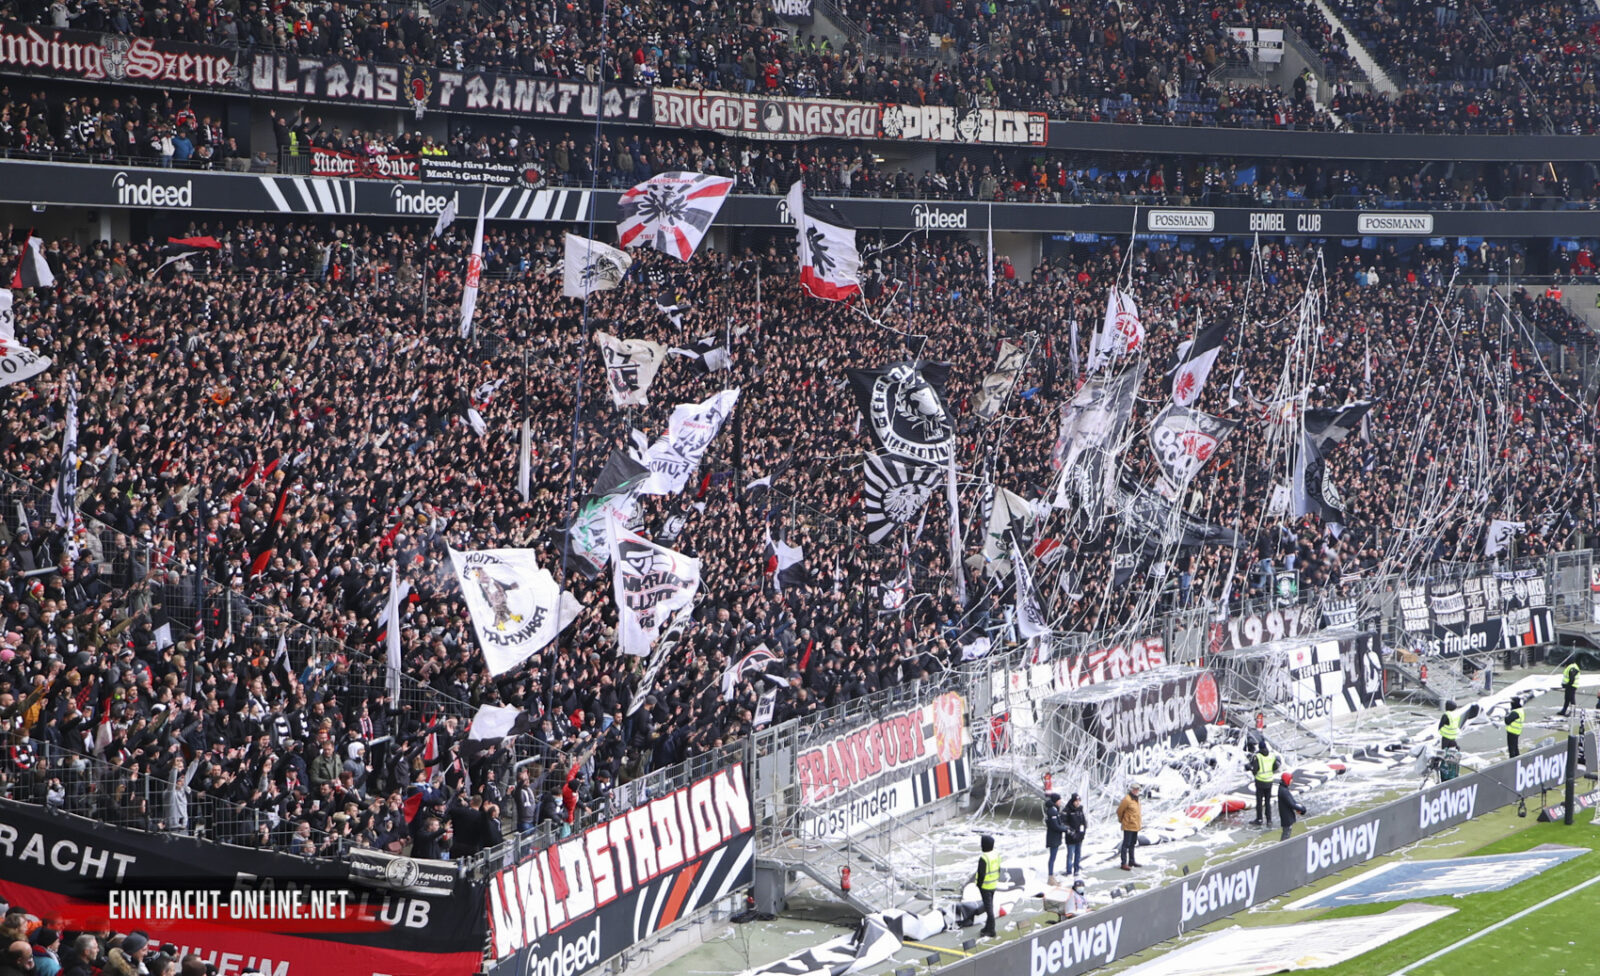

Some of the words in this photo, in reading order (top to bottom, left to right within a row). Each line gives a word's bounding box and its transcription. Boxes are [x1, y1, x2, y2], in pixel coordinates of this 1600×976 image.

[126, 37, 231, 84] Szene
[251, 54, 400, 100] ULTRAS
[438, 71, 648, 119] FRANKFURT
[653, 91, 758, 130] BRIGADE
[788, 102, 876, 137] NASSAU
[422, 159, 462, 169] Freunde
[463, 160, 484, 170] fürs
[462, 172, 482, 182] Gut
[484, 173, 511, 184] Peter
[115, 175, 193, 207] indeed
[914, 207, 968, 228] indeed
[1154, 215, 1209, 227] POSSMANN
[1250, 213, 1286, 231] BEMBEL
[1297, 214, 1322, 232] CLUB
[1365, 217, 1426, 229] POSSMANN
[1228, 606, 1301, 650] 1997
[1444, 628, 1487, 655] finden
[797, 706, 926, 806] FRANKFURT
[1516, 751, 1568, 792] betway
[851, 787, 897, 825] finden
[1419, 783, 1478, 829] betway
[488, 762, 752, 959] WALDSTADION
[1307, 818, 1380, 874] betway
[1181, 864, 1261, 922] betway
[527, 915, 600, 976] indeed
[1030, 916, 1123, 976] betway
